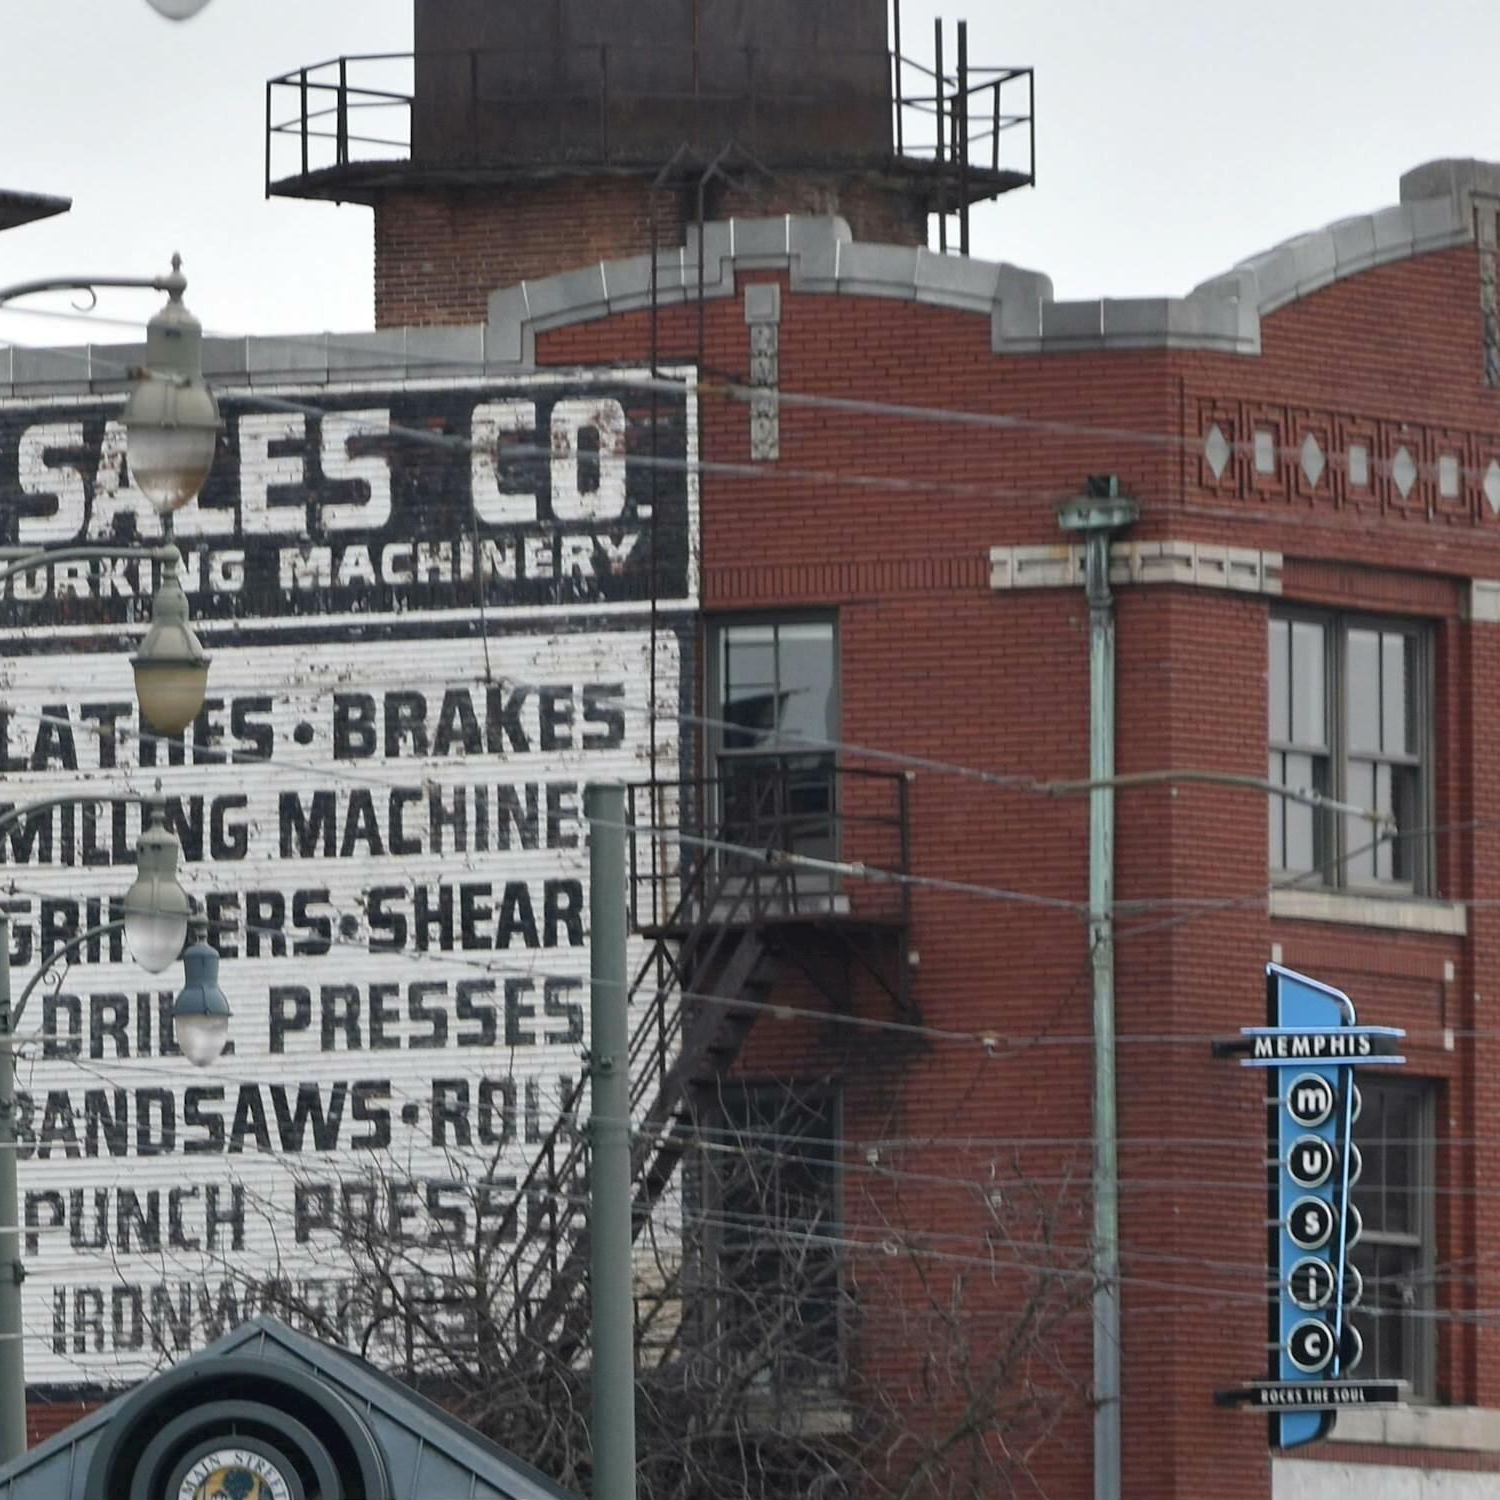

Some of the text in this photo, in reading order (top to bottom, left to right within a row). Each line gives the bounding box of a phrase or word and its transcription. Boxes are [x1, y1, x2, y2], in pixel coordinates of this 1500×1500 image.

[471, 397, 653, 525] CO.
[278, 532, 639, 591] MACHINERY
[332, 682, 627, 760] BRAKES
[279, 780, 591, 860] MACHINE
[269, 976, 584, 1055] PRESSES
[1254, 1033, 1372, 1058] MEMPHIS
[24, 1183, 246, 1256] PUNCH
[1260, 1386, 1366, 1404] ROCKS THE SOUL
[180, 1453, 223, 1493] MAIN
